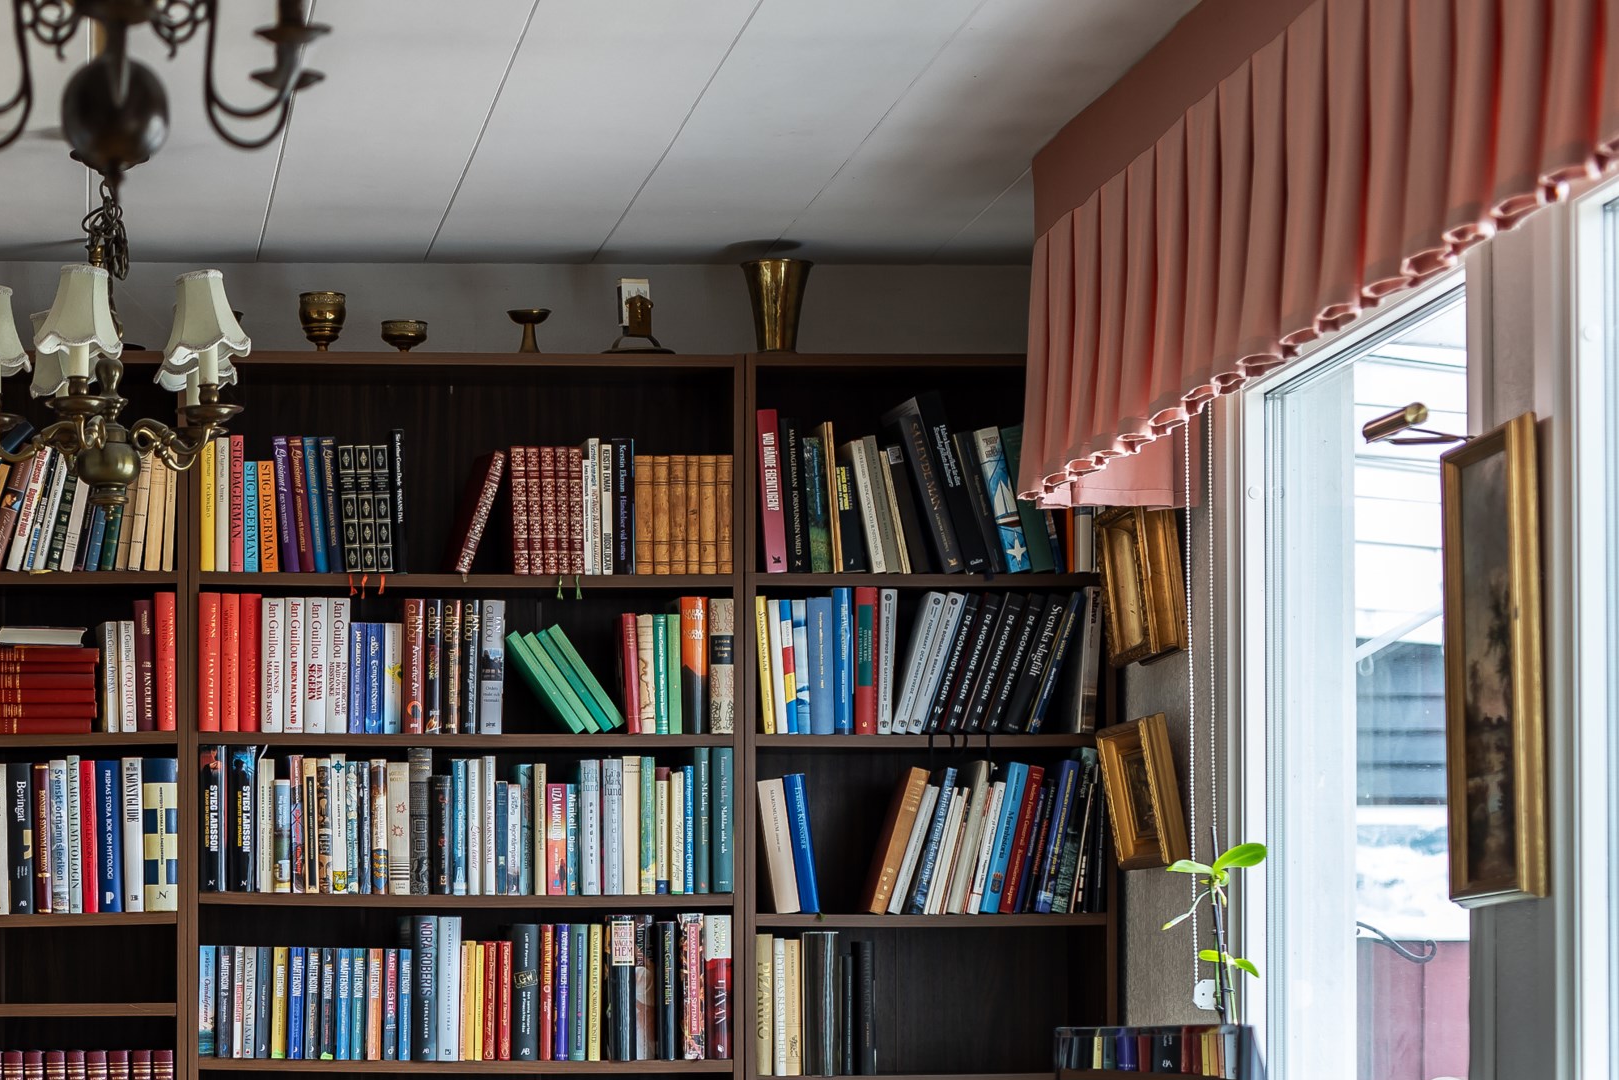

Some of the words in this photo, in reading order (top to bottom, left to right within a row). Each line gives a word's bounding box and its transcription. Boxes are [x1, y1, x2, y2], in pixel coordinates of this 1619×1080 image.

[762, 432, 776, 445] VAD
[619, 445, 627, 467] Kerstin
[763, 447, 777, 467] HÄNDE
[246, 465, 255, 489] STIG
[261, 464, 271, 491] STIG
[619, 469, 627, 492] Ekman
[766, 468, 781, 511] EGENTLIGEN?
[246, 493, 256, 558] DAGERMAN
[263, 494, 274, 560] DAGERMAN
[619, 495, 628, 527] Händelser
[290, 601, 301, 618] Jan
[984, 614, 992, 624] DE
[1043, 604, 1062, 641] Svenska
[1090, 590, 1100, 624] Poltava
[123, 623, 132, 634] Jan
[290, 620, 302, 659] Guillou
[123, 634, 132, 661] Guillou
[1029, 642, 1046, 676] slagfält
[125, 665, 134, 687] COQ
[959, 672, 973, 699] SLAGEN
[125, 690, 134, 726] ROUGE
[290, 684, 298, 704] MANS
[290, 704, 298, 724] LAND
[53, 769, 63, 803] Svenskt
[104, 770, 112, 794] PRISMAS
[125, 773, 139, 823] KONSTGUIDE
[242, 786, 251, 810] STIEG
[15, 781, 26, 822] Bevingat
[568, 793, 576, 829] Mankell
[106, 833, 113, 844] OM
[242, 812, 251, 852] LARSSON
[552, 803, 562, 841] MARKLUND
[998, 811, 1015, 858] Marinhistoria
[55, 806, 65, 881] ortnamnslexikon
[106, 846, 114, 880] MYTOLOGI
[421, 922, 431, 950] NORA
[370, 961, 380, 998] MÅRTENSON
[421, 953, 432, 996] ROBERTS
[757, 962, 770, 1040] PIZARRO
